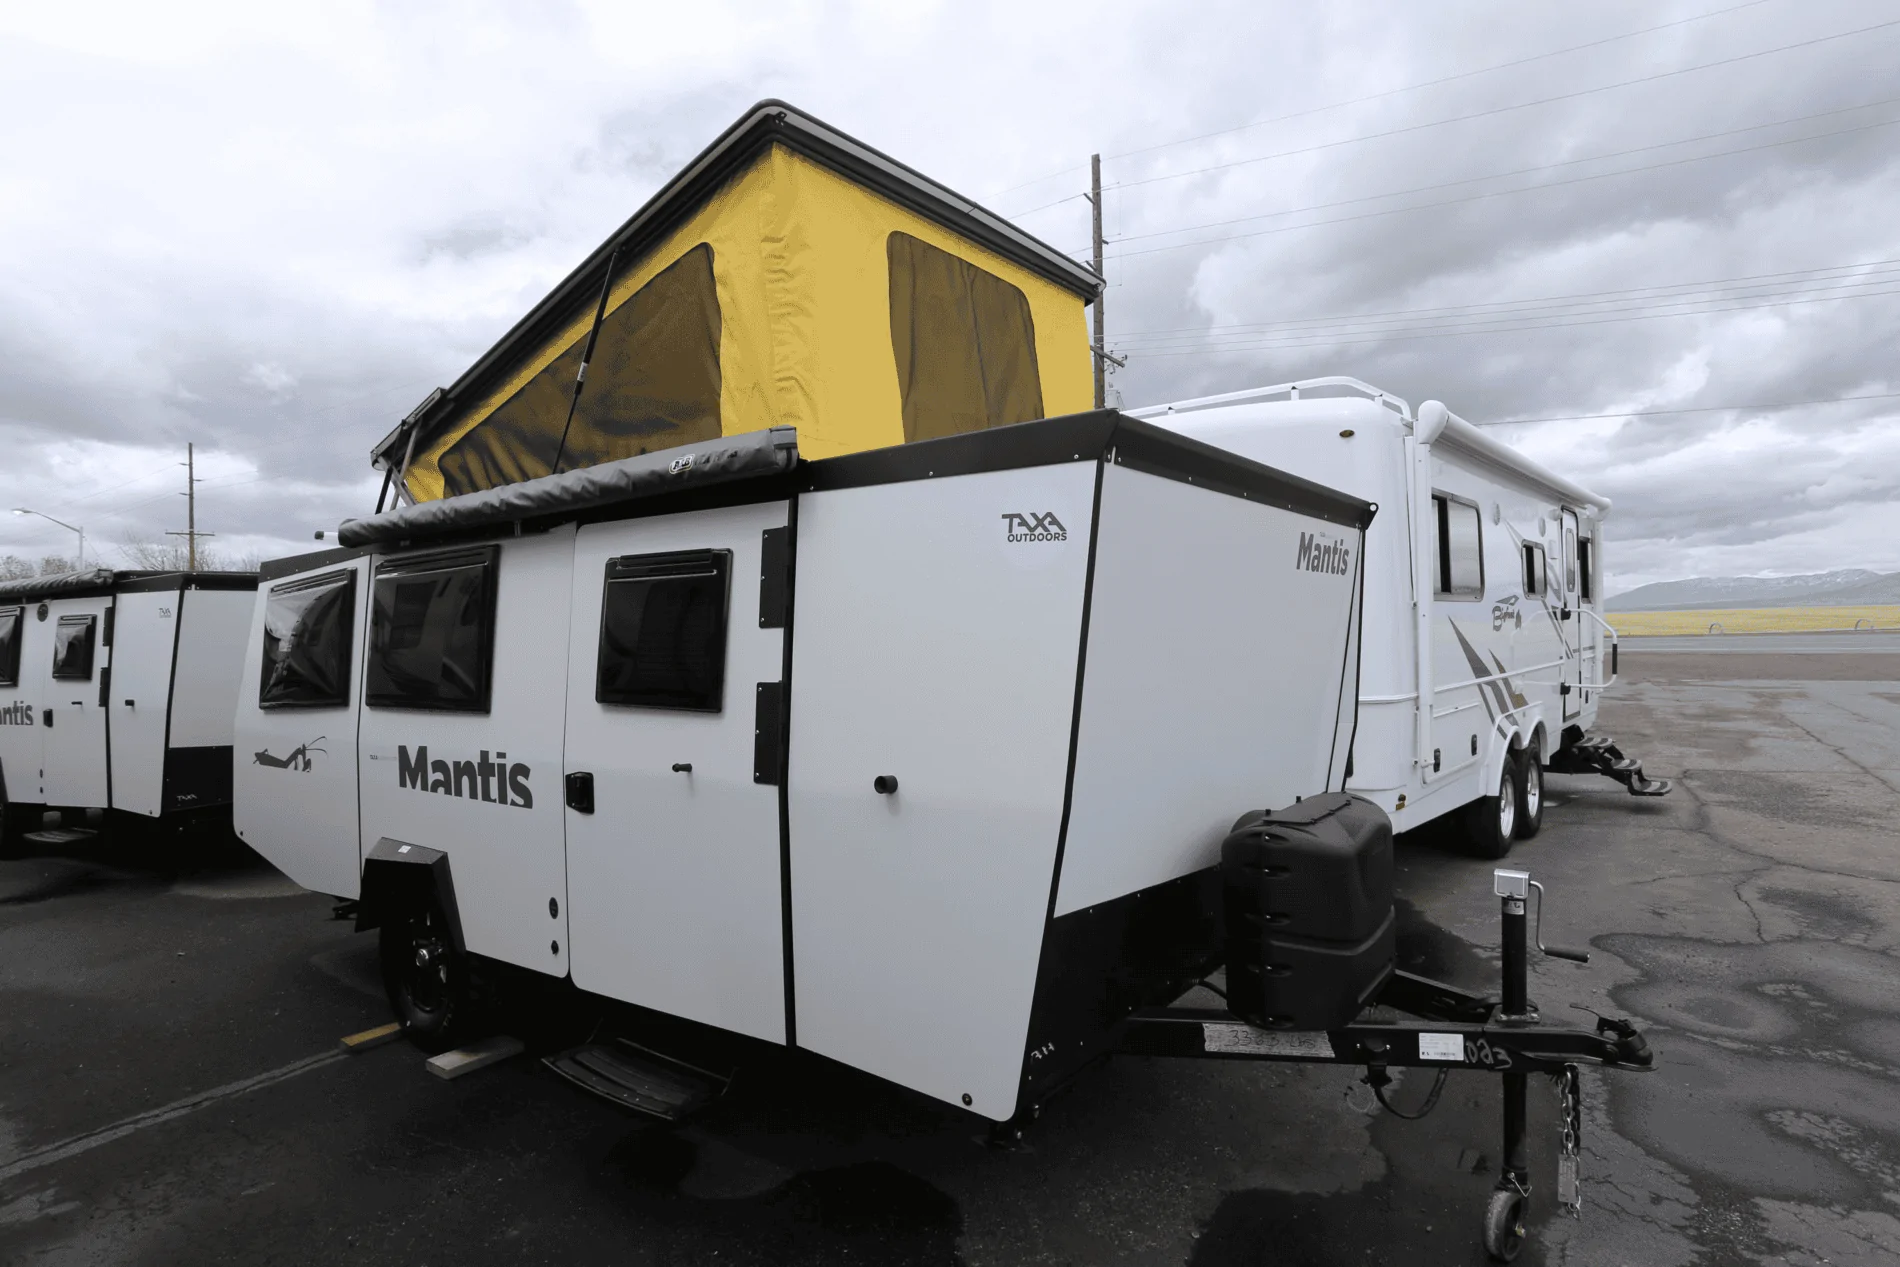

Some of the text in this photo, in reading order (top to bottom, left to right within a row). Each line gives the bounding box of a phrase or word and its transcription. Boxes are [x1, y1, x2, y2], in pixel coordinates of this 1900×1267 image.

[1001, 511, 1067, 534] TAXA
[1007, 532, 1067, 543] OUTDOORS
[1296, 531, 1350, 576] Mantis
[0, 700, 34, 726] ntis
[398, 745, 533, 810] Mantis
